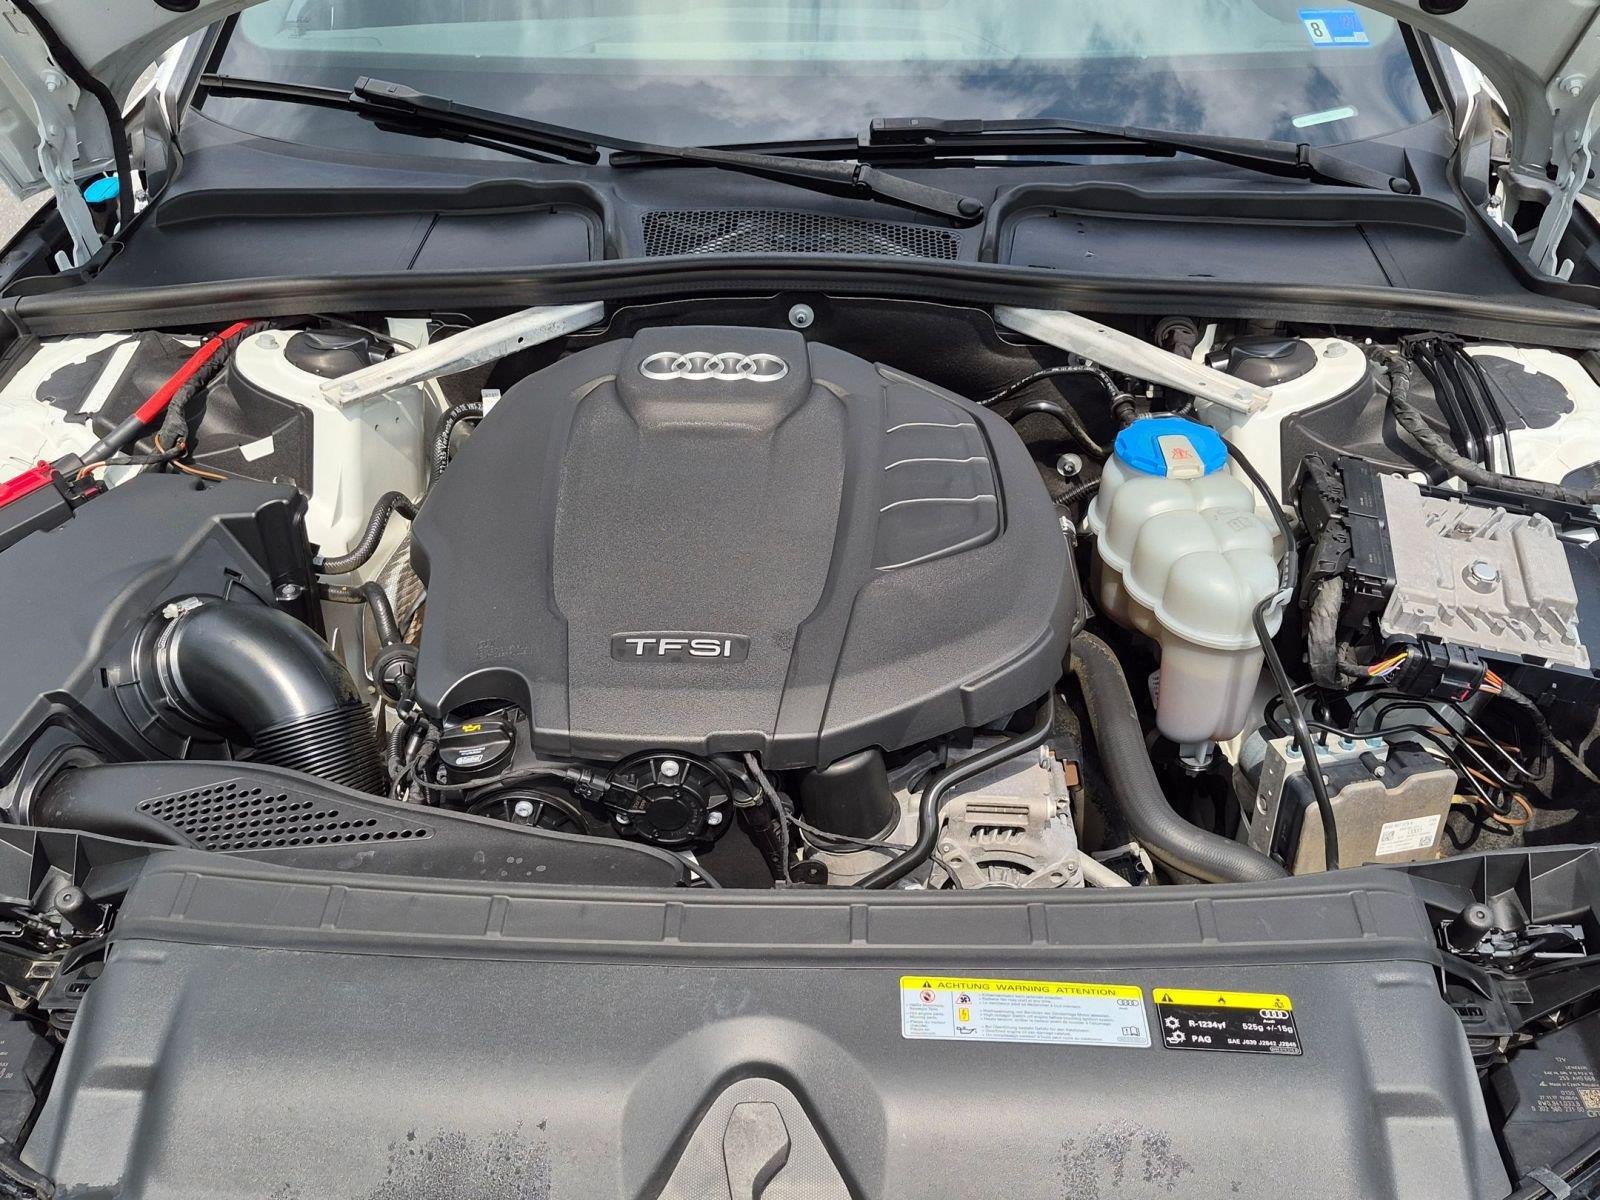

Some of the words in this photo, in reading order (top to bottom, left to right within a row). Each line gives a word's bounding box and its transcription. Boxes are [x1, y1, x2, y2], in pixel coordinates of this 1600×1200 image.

[1310, 22, 1323, 37] 8
[626, 638, 732, 657] TFSI
[937, 981, 990, 990] ACHTUNG
[996, 984, 1050, 993] WARNING
[1056, 986, 1116, 996] ATTENTION
[1189, 1020, 1226, 1030] R-1234yf
[1242, 1023, 1264, 1032] 525g
[1266, 1025, 1294, 1034] +/-15g
[1191, 1035, 1212, 1043] PAG
